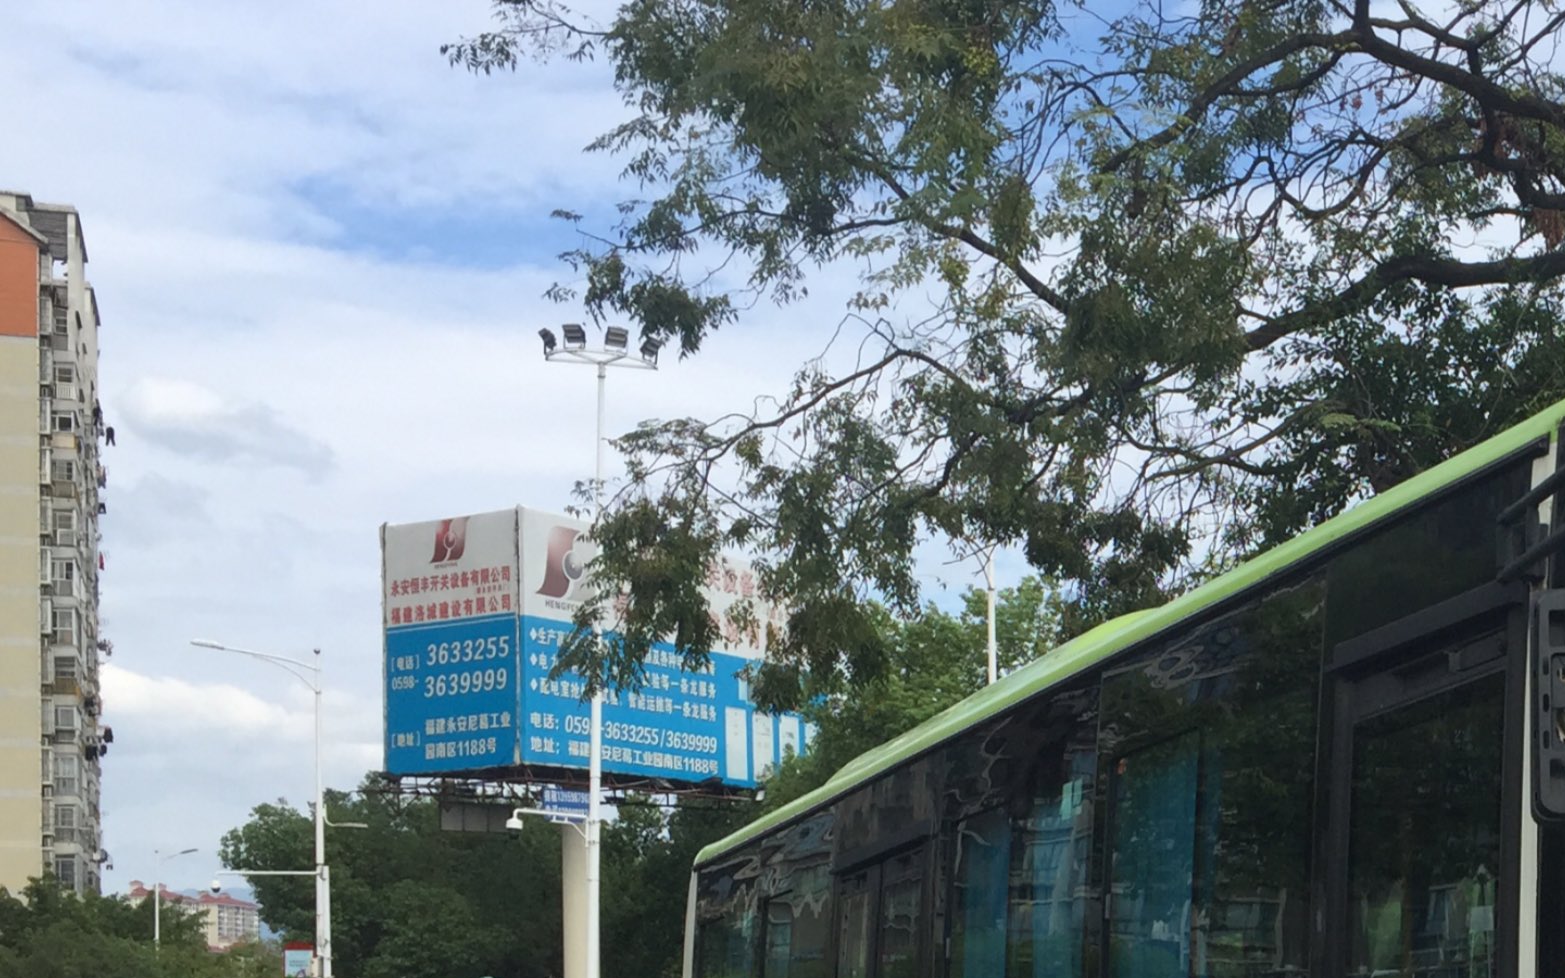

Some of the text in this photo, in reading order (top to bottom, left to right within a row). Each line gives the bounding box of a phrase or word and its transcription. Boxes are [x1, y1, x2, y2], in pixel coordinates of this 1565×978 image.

[426, 636, 510, 666] 3633255
[423, 668, 508, 698] 3639999
[564, 714, 718, 754] 059-3633255/3639999
[568, 739, 719, 775] 福建安尼葛工业园南区1188号
